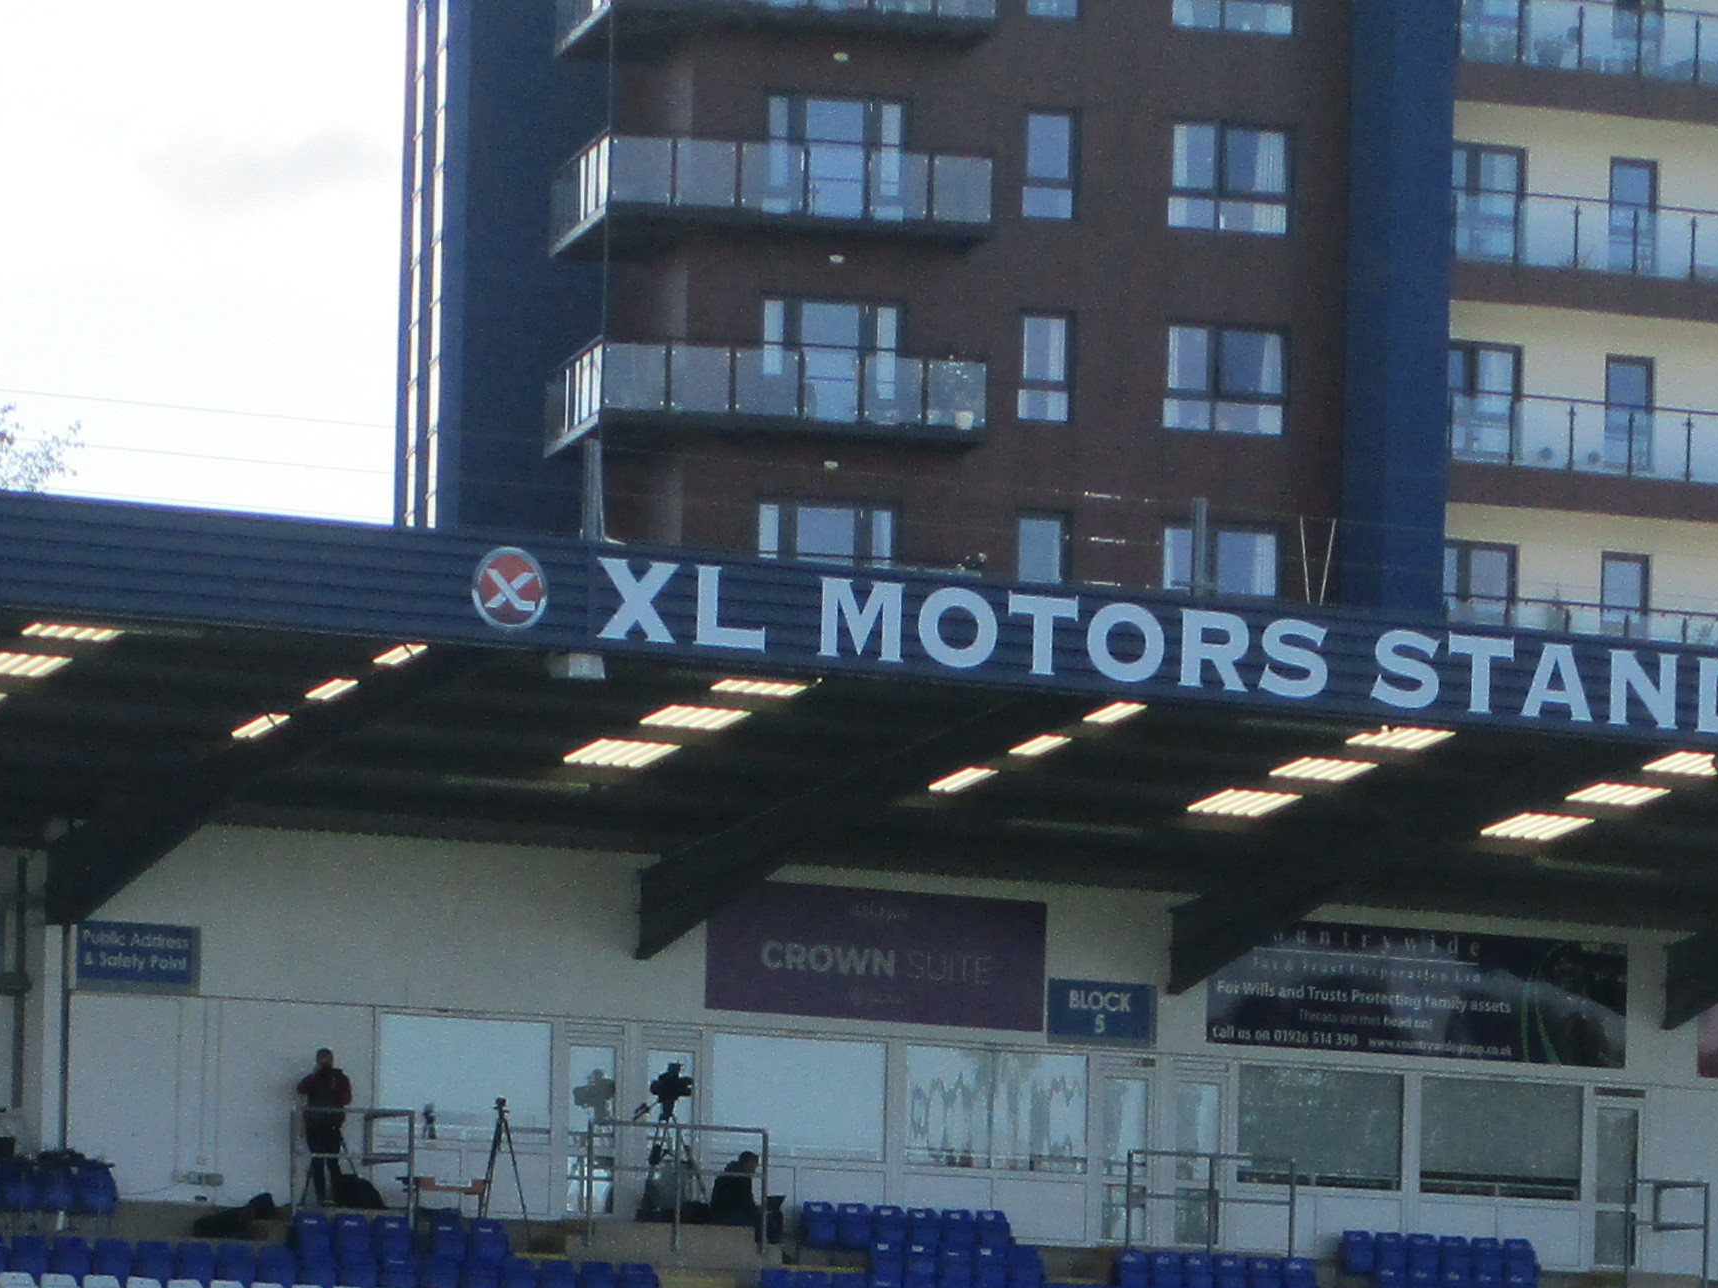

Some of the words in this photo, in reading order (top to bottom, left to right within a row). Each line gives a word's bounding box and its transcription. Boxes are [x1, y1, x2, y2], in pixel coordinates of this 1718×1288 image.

[597, 556, 766, 652] XL
[817, 576, 1329, 699] MOTORS
[83, 929, 125, 947] Public
[130, 933, 189, 949] Address
[99, 952, 145, 972] Safety
[150, 954, 187, 970] Point
[761, 940, 896, 978] CROWN
[908, 950, 993, 985] SUITE
[1069, 989, 1131, 1012] BLOCK
[1217, 980, 1240, 996] For
[1243, 981, 1276, 998] Wills
[1278, 984, 1305, 1000] and
[1308, 986, 1348, 1003] Trusts
[1351, 989, 1422, 1011] Protecting
[1425, 994, 1467, 1013] family
[1470, 999, 1512, 1014] assets
[1094, 1013, 1106, 1034] 5
[1212, 1025, 1235, 1040] Call
[1236, 1028, 1251, 1040] us
[1254, 1029, 1271, 1042] on
